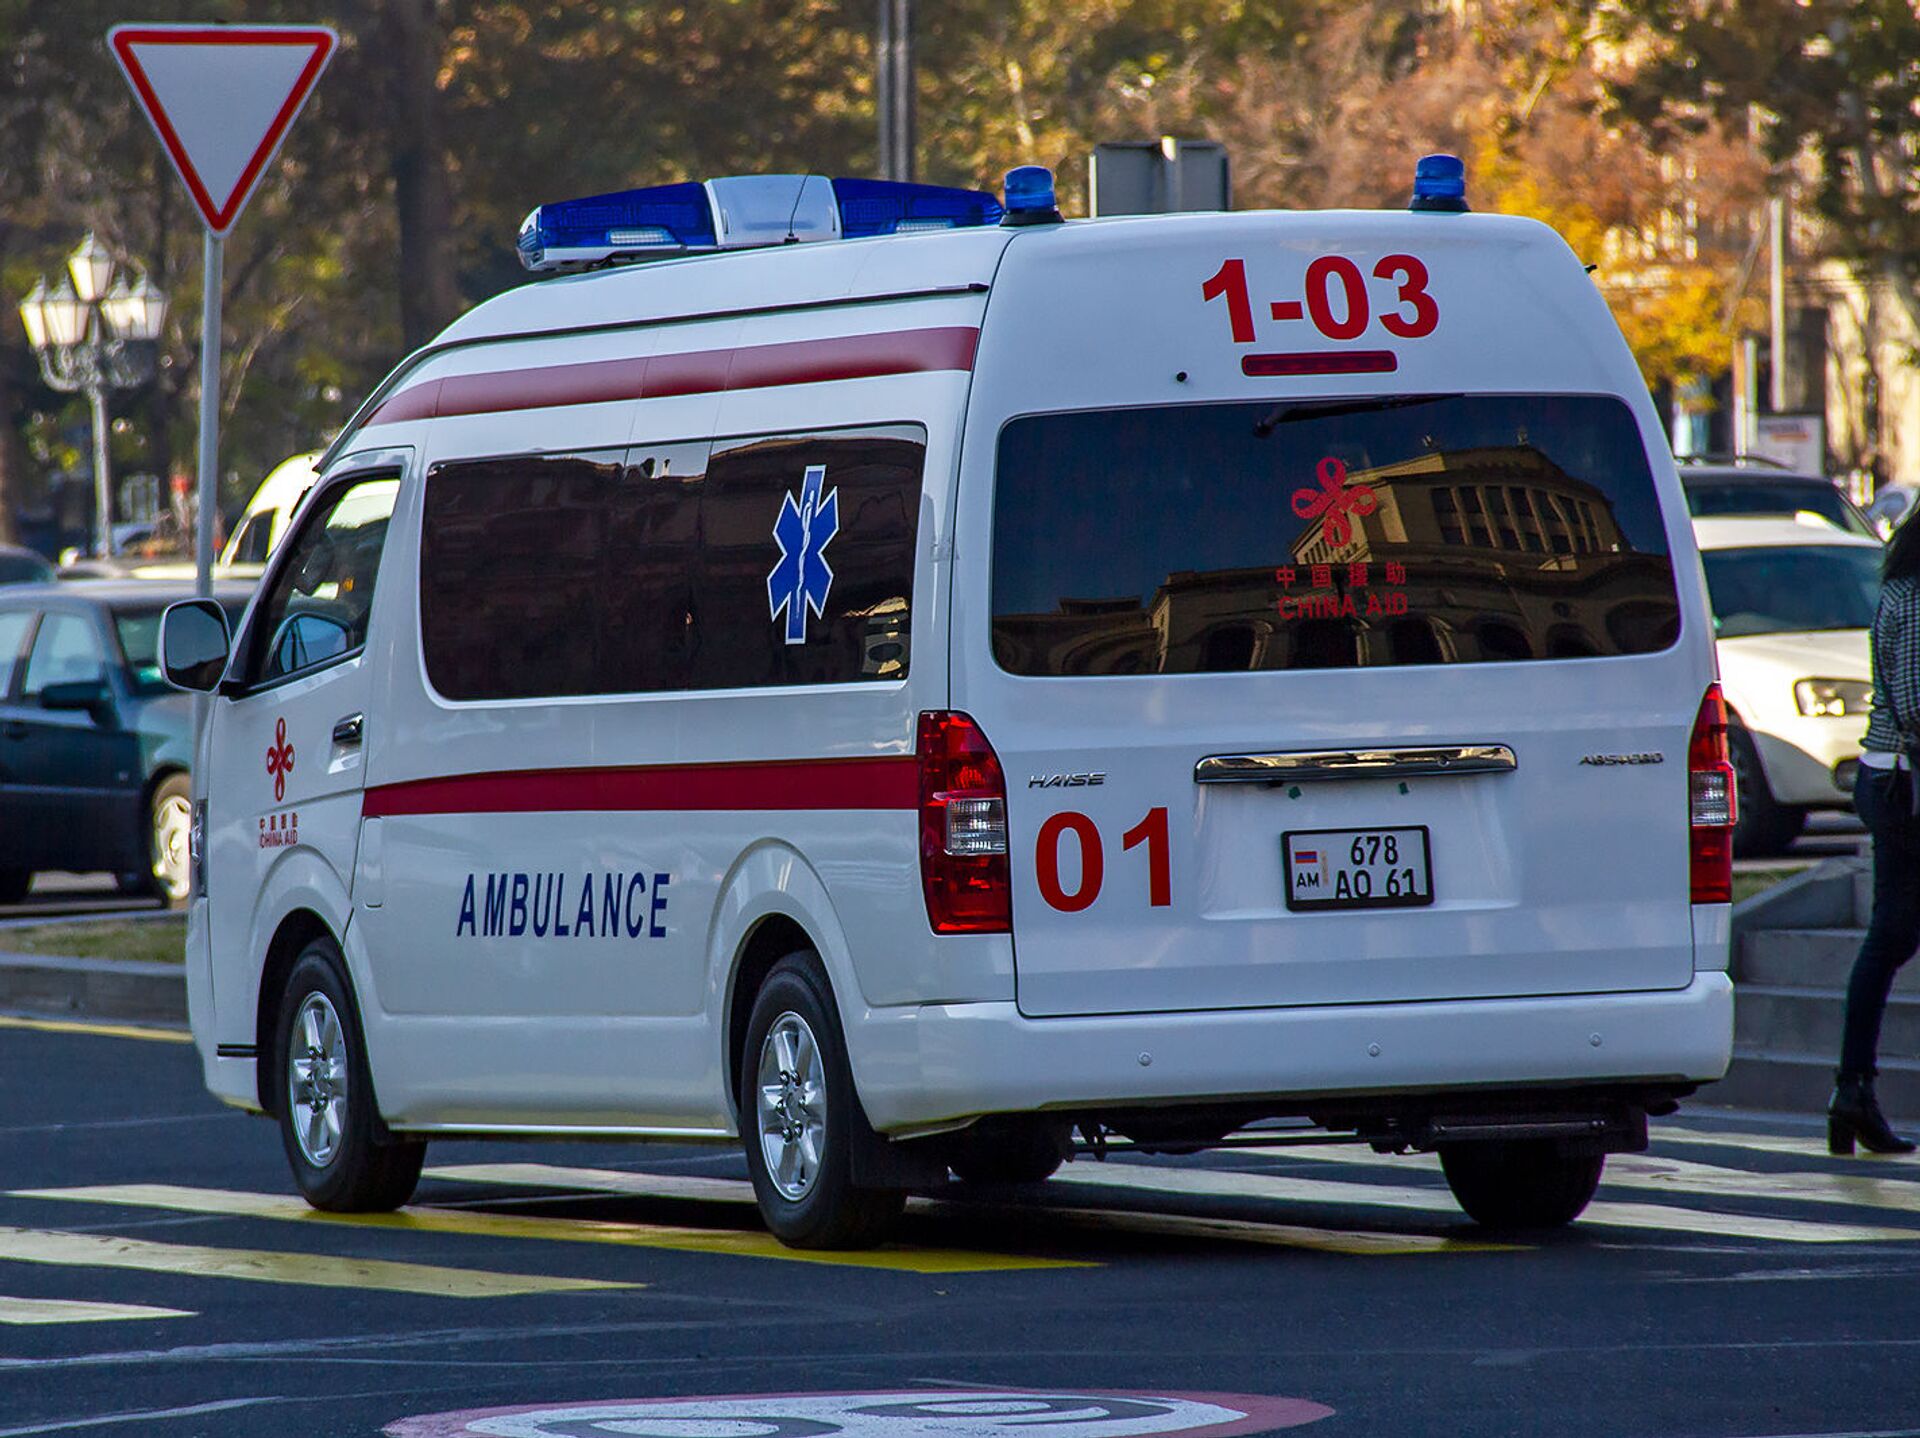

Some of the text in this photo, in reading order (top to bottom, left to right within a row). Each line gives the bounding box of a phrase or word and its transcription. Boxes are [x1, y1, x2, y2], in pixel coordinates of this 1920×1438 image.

[1201, 254, 1440, 343] 1-03
[1275, 560, 1407, 590] 中国援助
[1278, 591, 1408, 620] CHINA AID
[1028, 771, 1107, 788] HAISE
[1035, 806, 1172, 913] 01
[1350, 835, 1399, 866] 678
[1296, 872, 1320, 888] AM
[1336, 868, 1418, 899] AO 61
[456, 872, 671, 938] AMBULANCE
